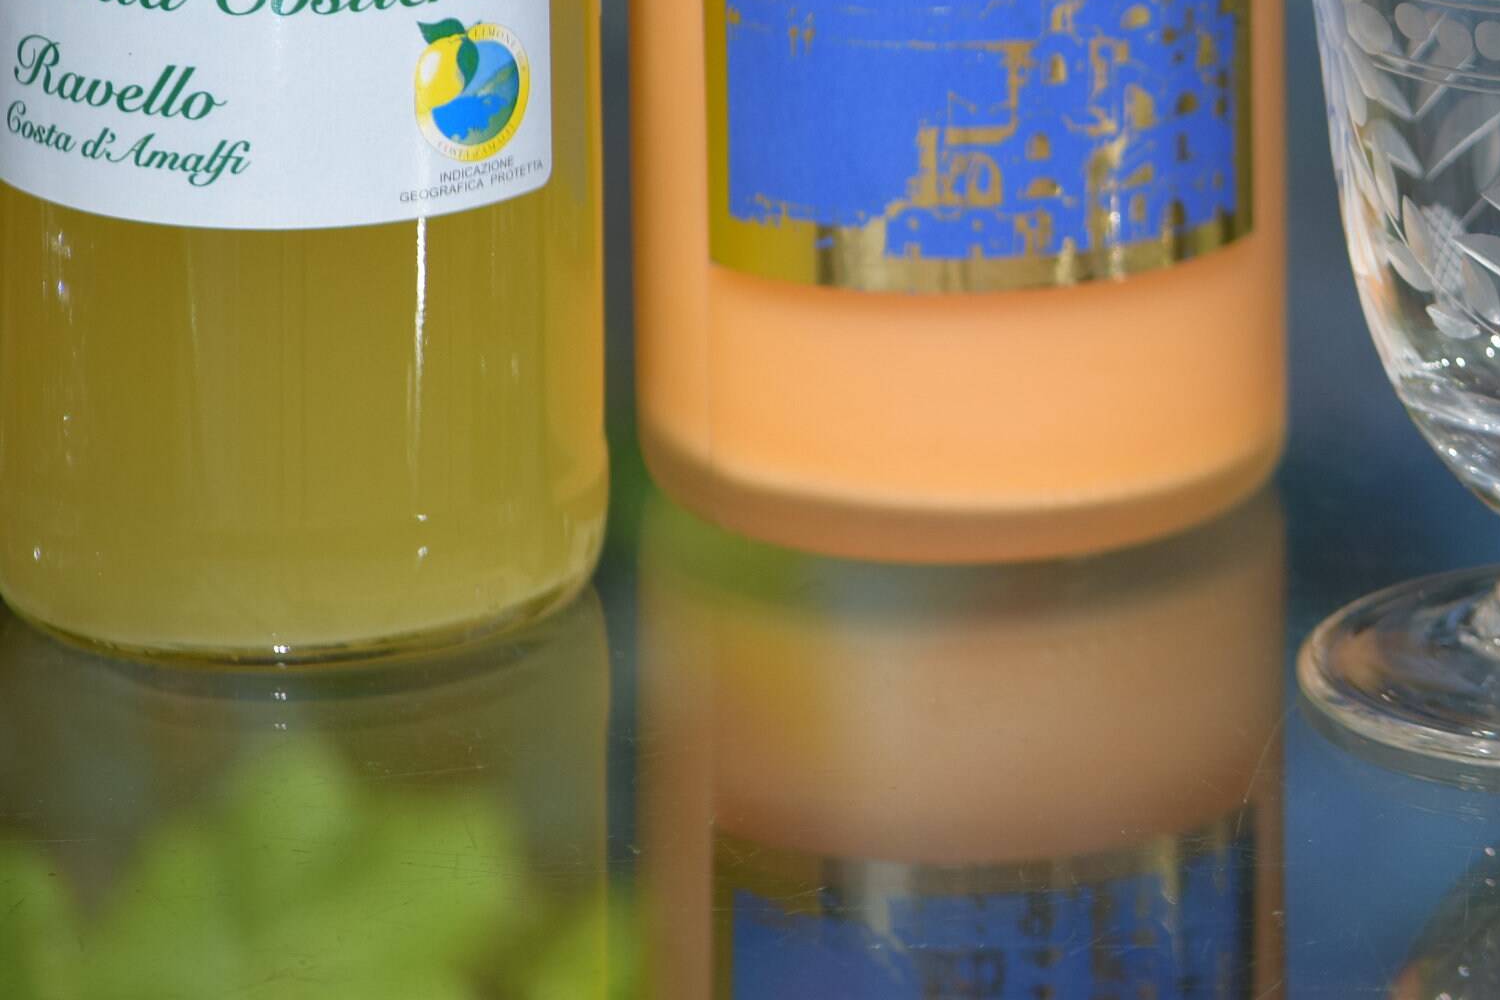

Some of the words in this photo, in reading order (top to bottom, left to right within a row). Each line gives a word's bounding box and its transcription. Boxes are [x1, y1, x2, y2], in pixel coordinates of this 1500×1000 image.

[14, 34, 228, 120] Ravello
[7, 100, 76, 153] Costa
[399, 180, 484, 203] GEOGRAFICA
[490, 159, 544, 185] PROTETTA
[439, 155, 515, 184] INDICAZIONE
